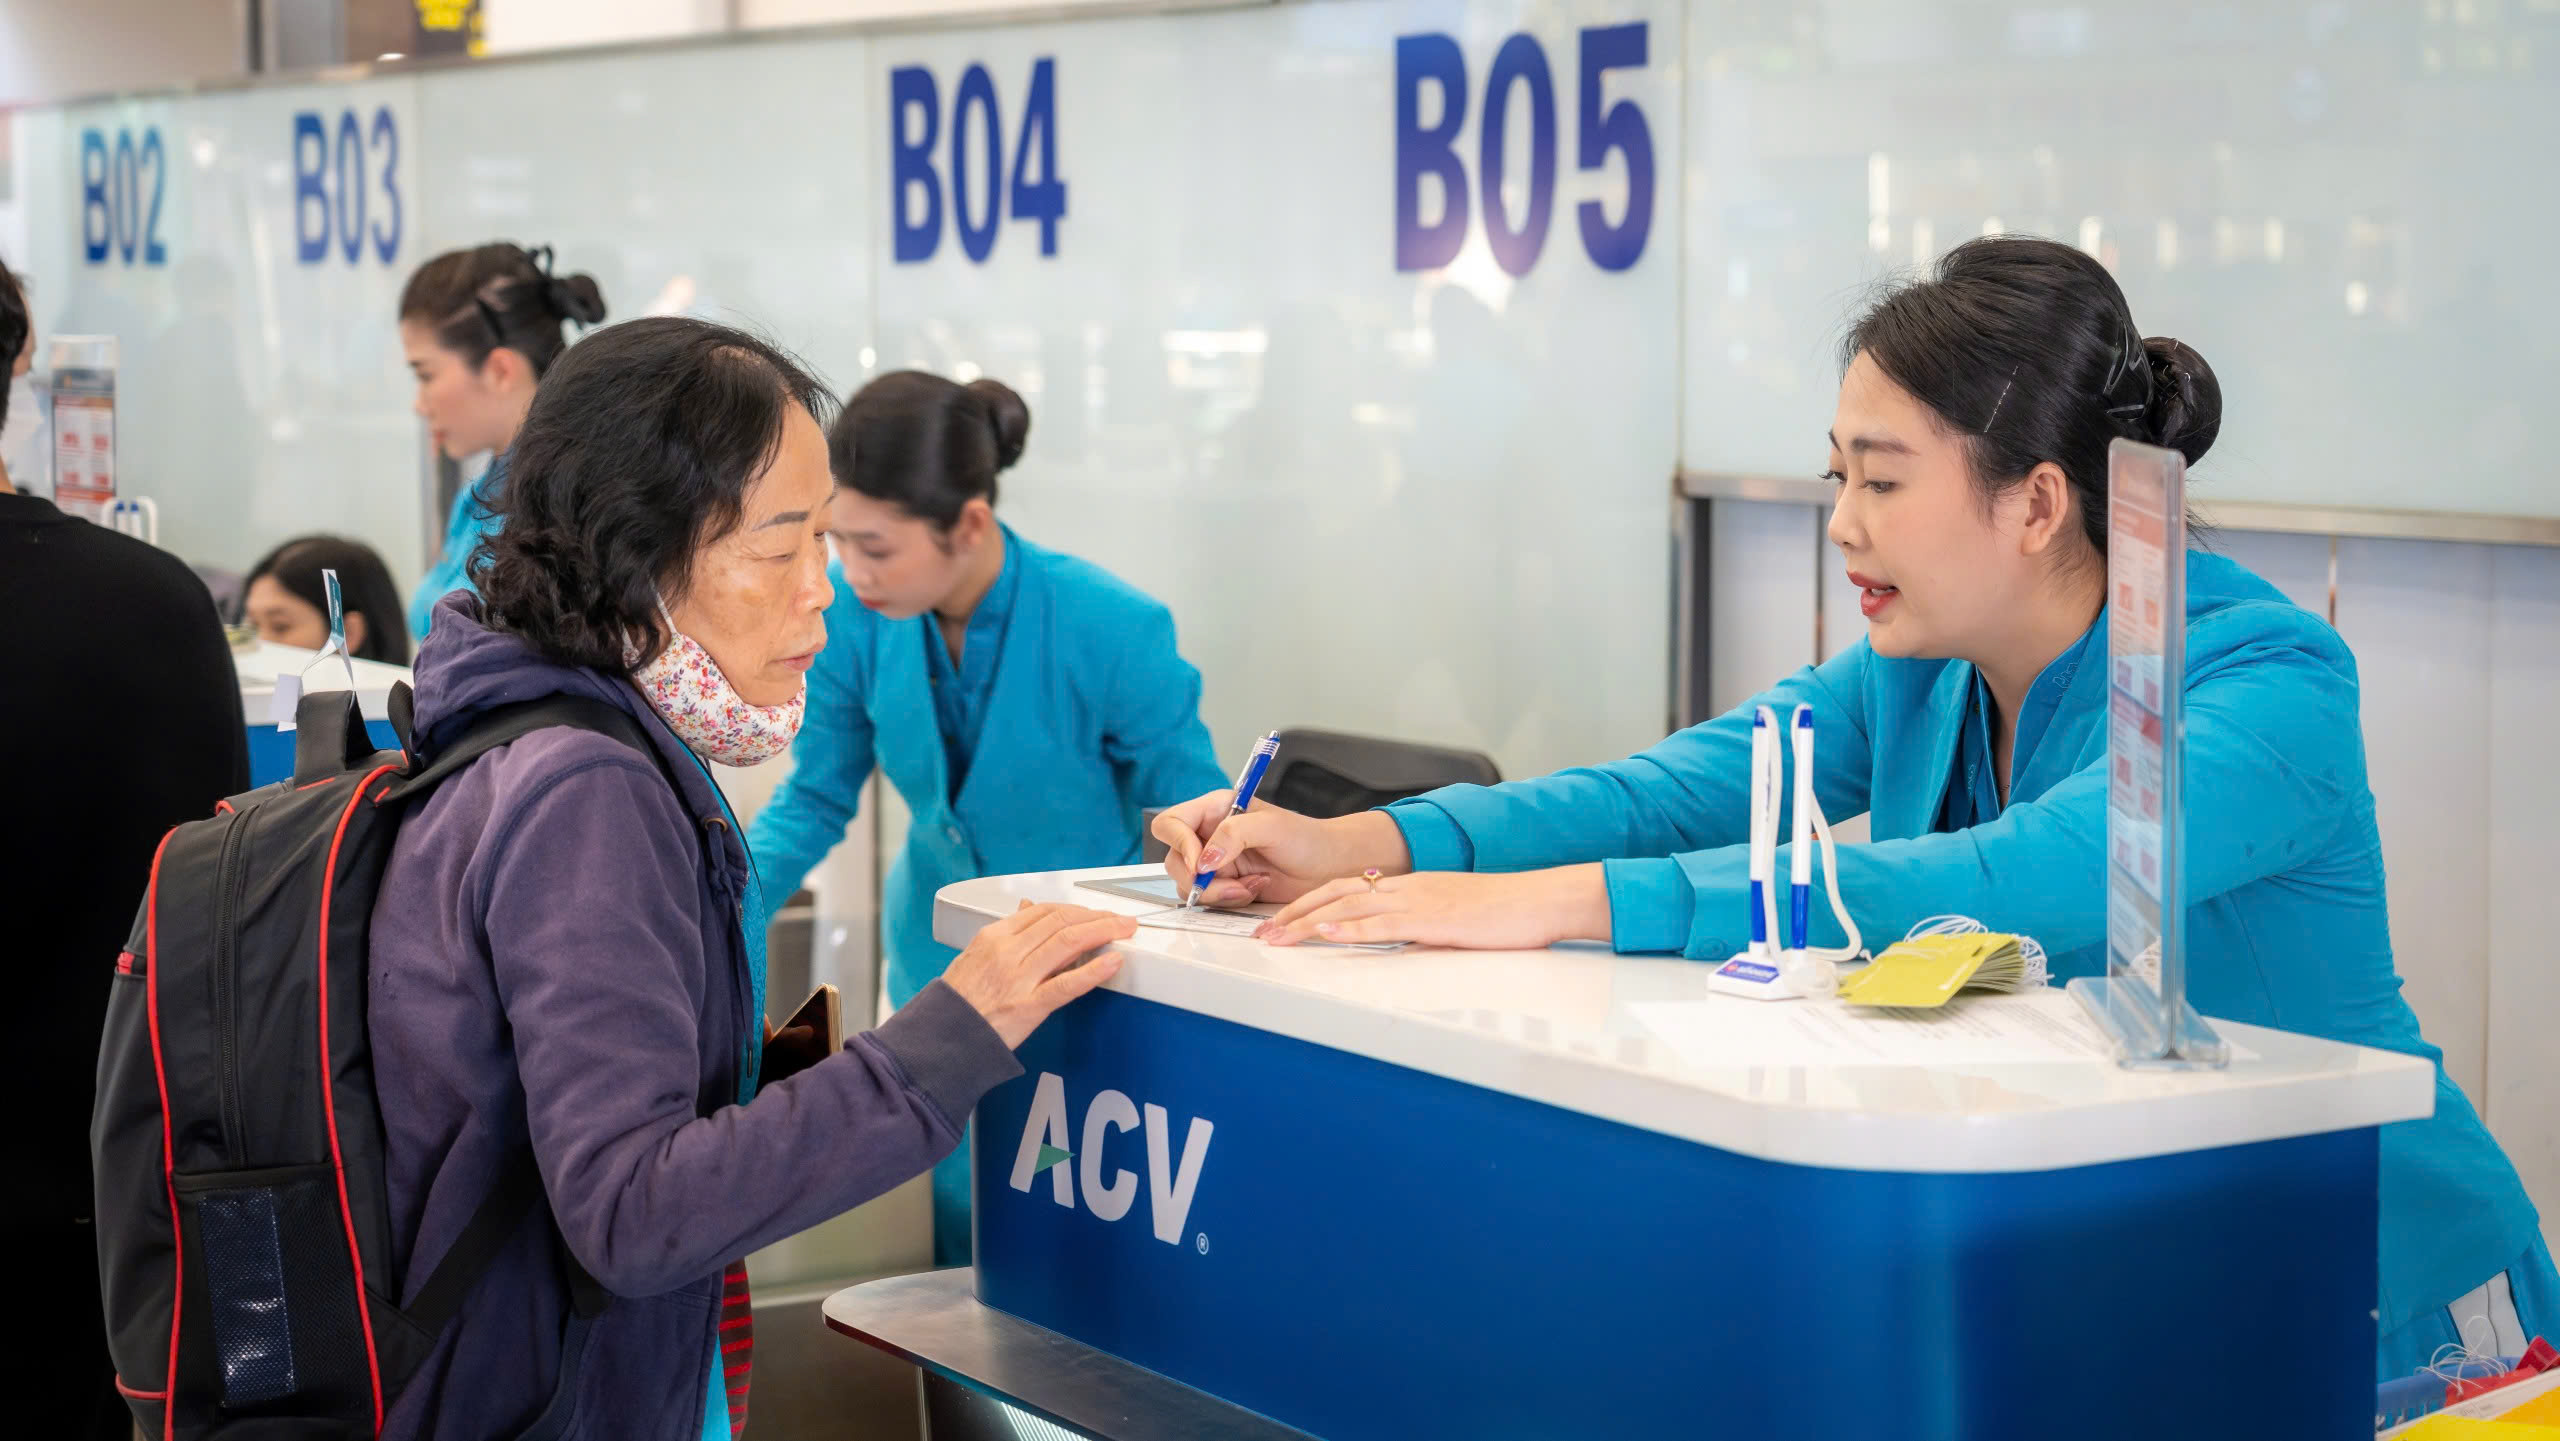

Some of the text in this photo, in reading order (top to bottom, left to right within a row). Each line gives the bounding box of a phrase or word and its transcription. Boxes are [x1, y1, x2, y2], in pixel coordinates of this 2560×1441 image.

[82, 125, 168, 265] B02
[294, 104, 401, 266] B03
[890, 55, 1068, 265] B04
[1395, 20, 1656, 277] B05
[1009, 1071, 1215, 1246] ACV
